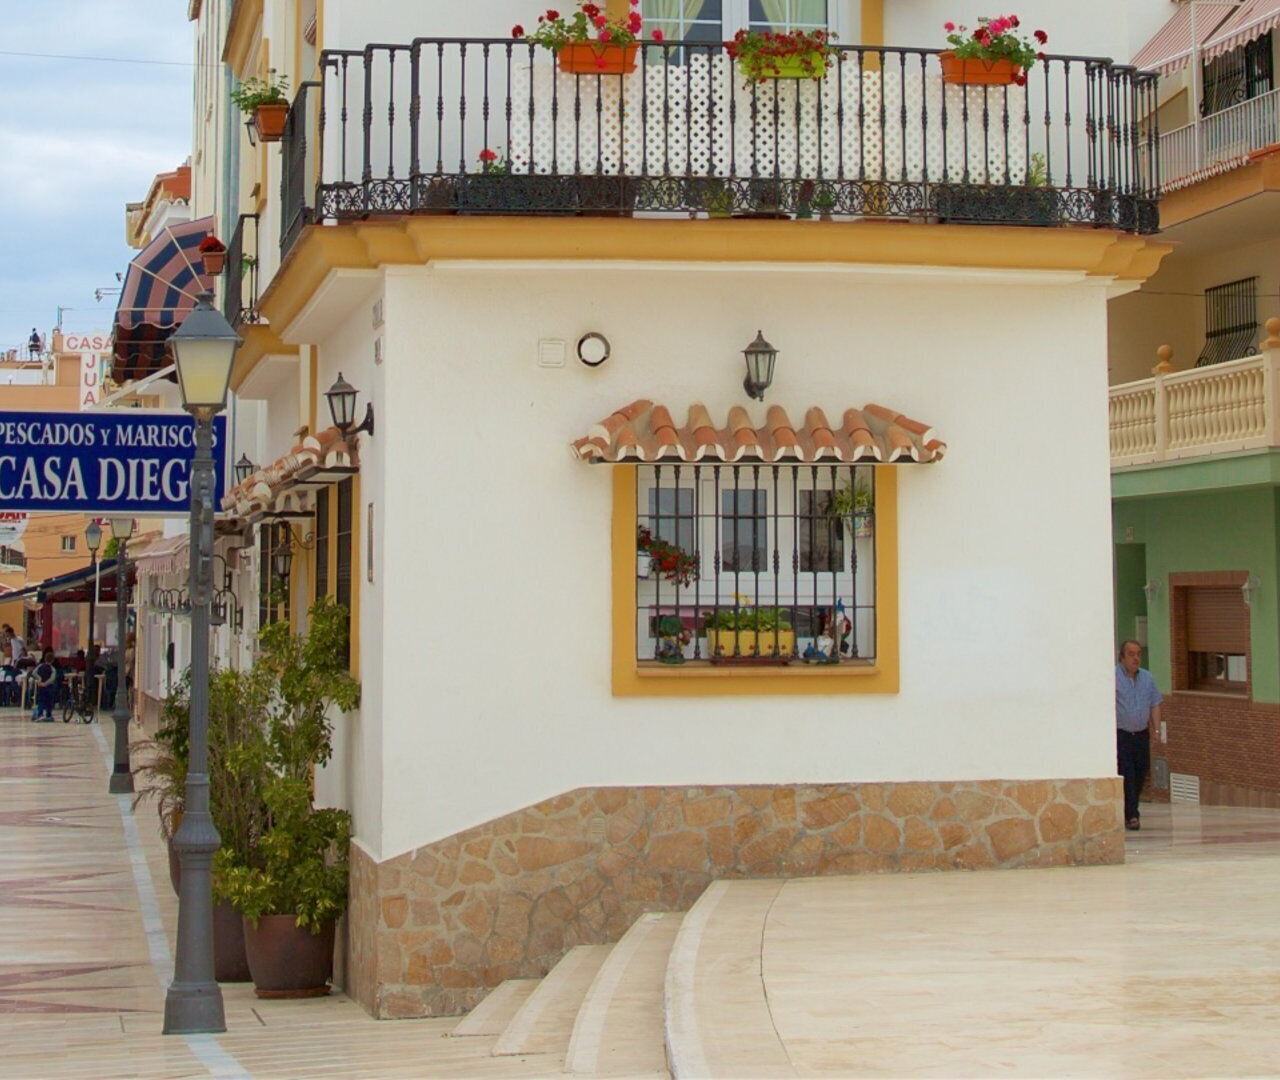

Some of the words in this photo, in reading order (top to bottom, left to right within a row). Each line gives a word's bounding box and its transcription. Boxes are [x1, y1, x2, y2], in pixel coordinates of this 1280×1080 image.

[83, 353, 97, 406] JUA
[114, 424, 217, 448] MARISCS
[97, 457, 217, 503] DIEG
